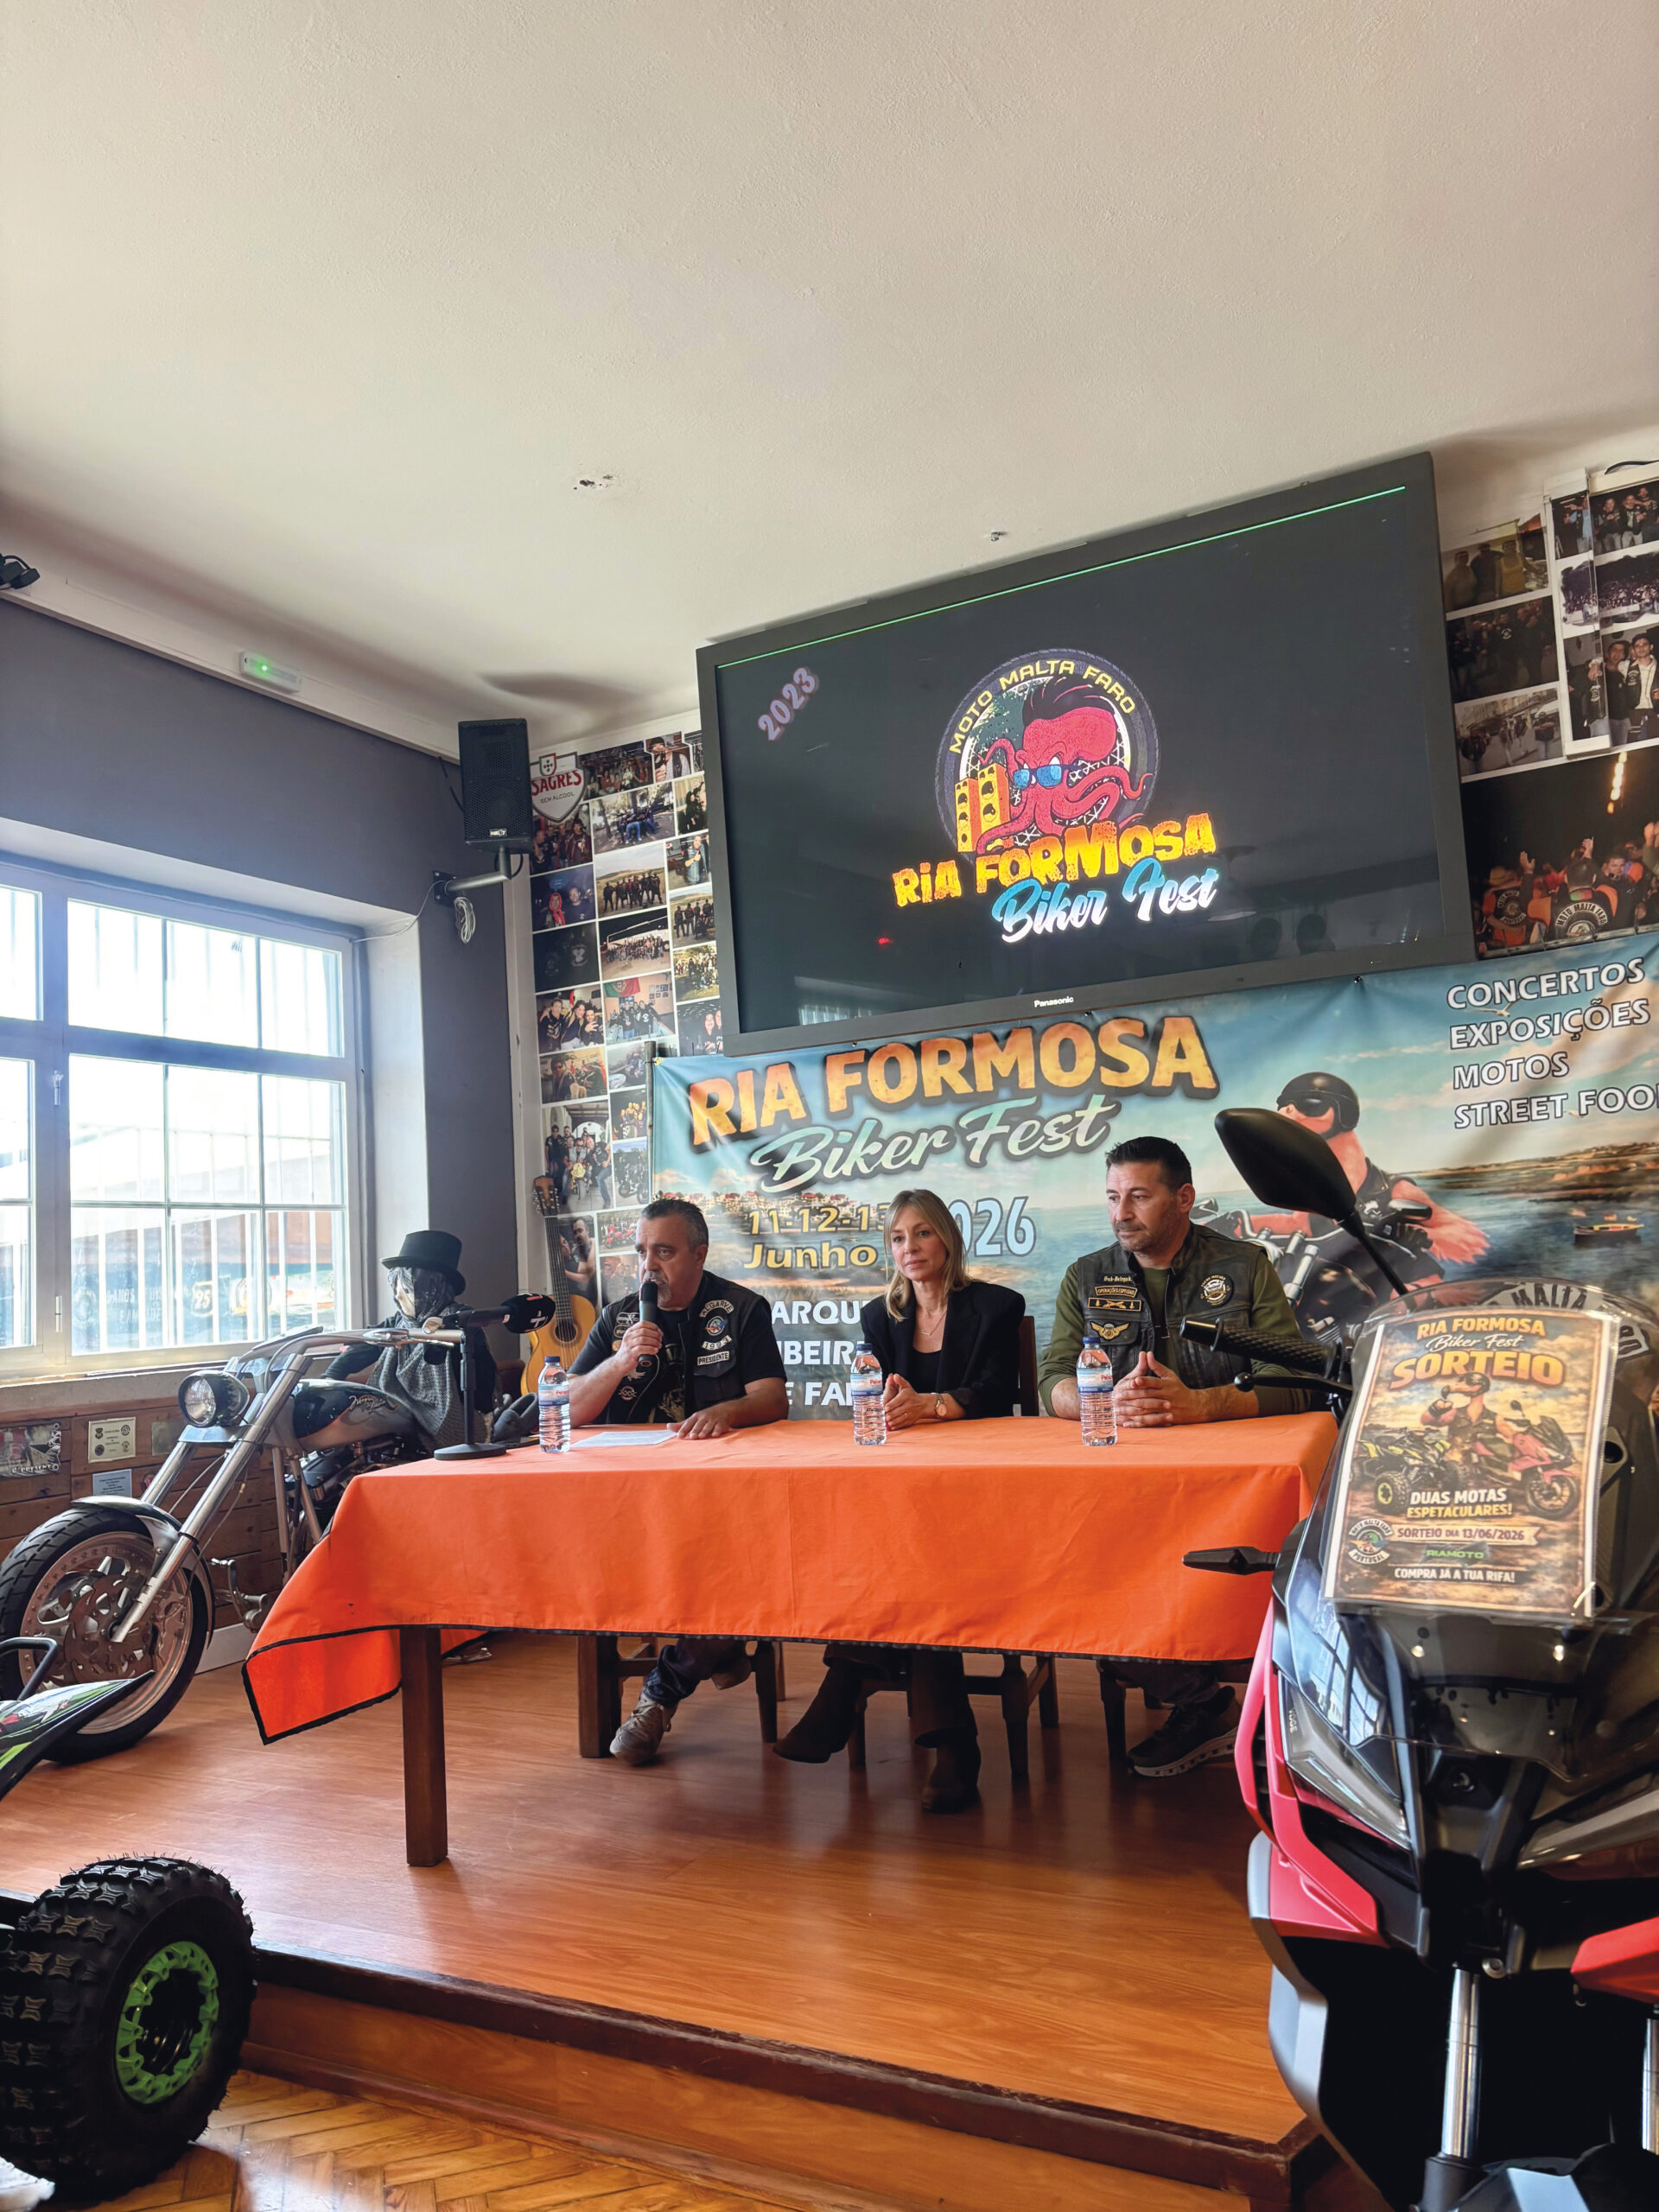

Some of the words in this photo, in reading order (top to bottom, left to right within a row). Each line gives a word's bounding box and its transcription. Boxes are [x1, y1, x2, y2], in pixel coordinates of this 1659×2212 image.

[758, 667, 817, 741] 2023
[950, 690, 994, 753] MOTO
[999, 660, 1075, 690] MALTA
[1083, 665, 1136, 714] FARO
[531, 770, 582, 796] SAGRES
[976, 812, 1217, 893] FORMOSA
[991, 879, 1108, 943] Biker
[1122, 858, 1219, 921] Fest
[1446, 957, 1646, 1009] CONCERTOS
[1034, 995, 1074, 1007] Panasonic
[1450, 997, 1651, 1050] EXPOSIÇÕES
[689, 1062, 807, 1146] RIA
[825, 1016, 1217, 1114] FORMOSA
[1453, 1052, 1569, 1090] MOTOS
[1454, 1093, 1568, 1128] STREET
[1578, 1084, 1659, 1117] FOO
[750, 1119, 951, 1193] Biker
[959, 1094, 1118, 1166] Fest
[950, 1196, 1035, 1257] 026
[744, 1243, 878, 1269] Junho
[702, 1300, 733, 1315] ALGARVE
[771, 1300, 871, 1324] ARQU
[1417, 1323, 1446, 1340] RIA
[1452, 1318, 1546, 1337] FORMOSA
[1426, 1334, 1481, 1352] Biker
[1485, 1333, 1523, 1349] Fest
[698, 1352, 729, 1364] PRESIDENTE
[1390, 1351, 1564, 1389] SORTEIO
[1410, 1491, 1451, 1505] DUAS
[1454, 1488, 1507, 1503] MOTAS
[1407, 1503, 1513, 1518] ESPETACULARES!
[1397, 1528, 1442, 1538] SORTEIO
[1462, 1529, 1525, 1541] 13/06/2026
[1352, 1552, 1385, 1563] PORTUGAL
[1426, 1549, 1484, 1559] RIAMOTO
[1395, 1567, 1437, 1579] COMPRA
[1453, 1569, 1461, 1580] A
[1464, 1569, 1484, 1580] TUA
[1486, 1571, 1516, 1583] RIFA!
